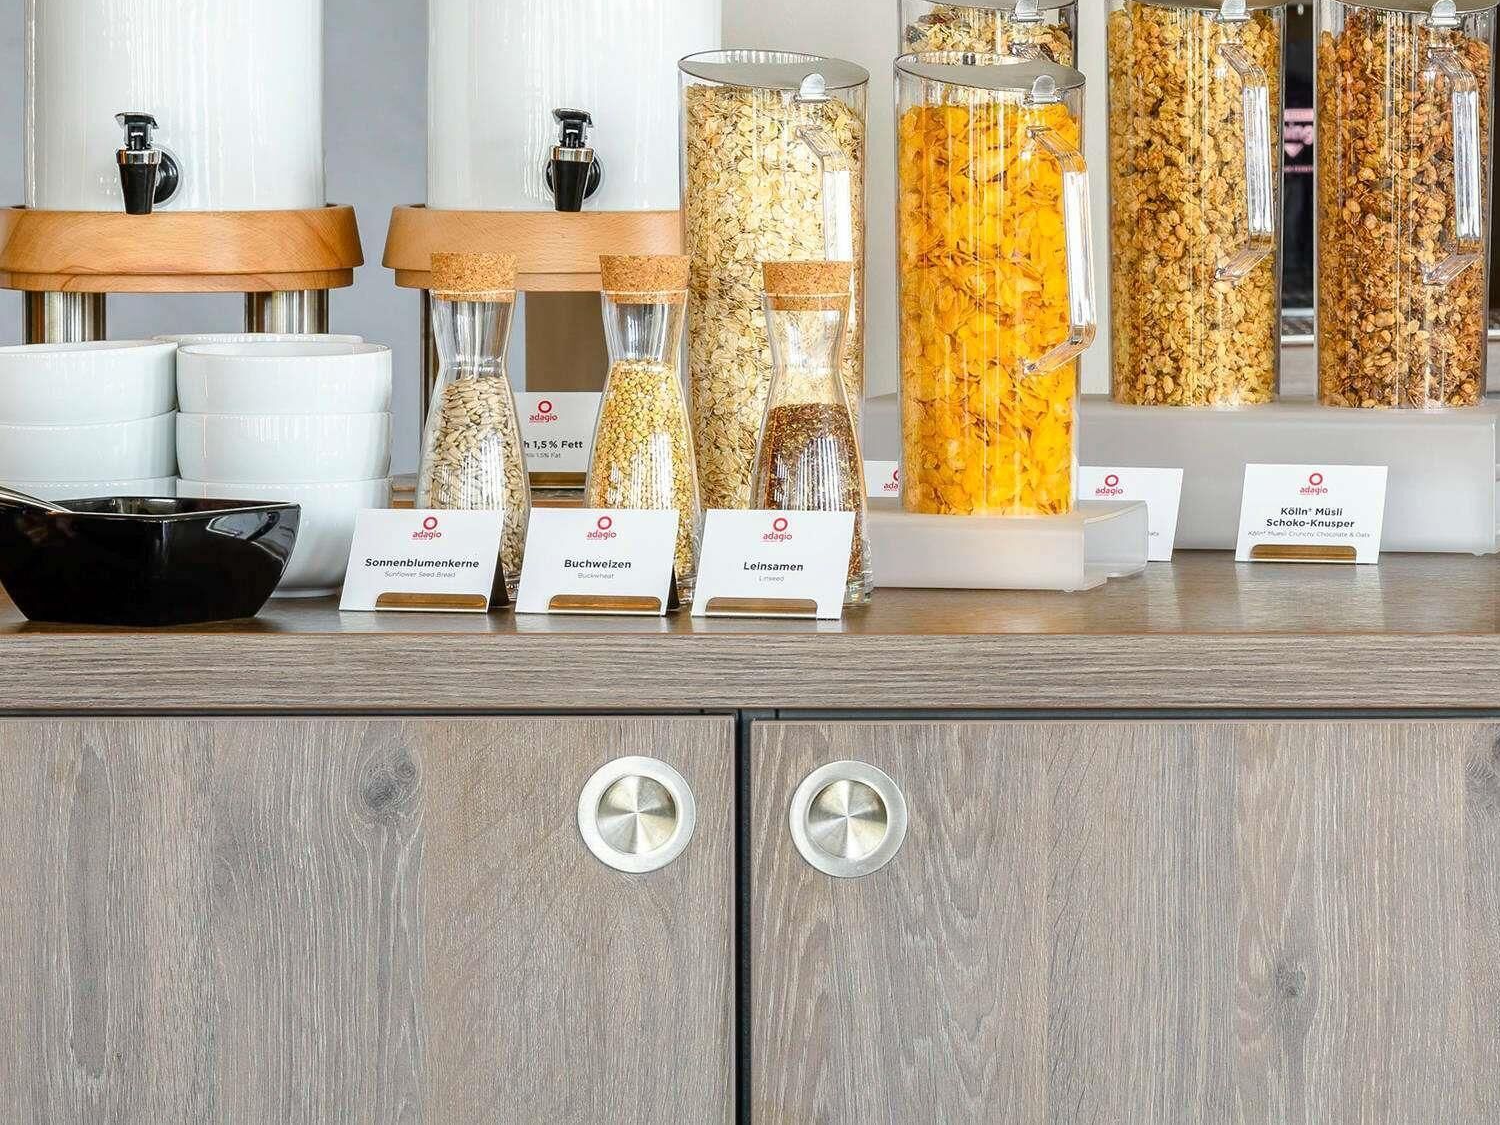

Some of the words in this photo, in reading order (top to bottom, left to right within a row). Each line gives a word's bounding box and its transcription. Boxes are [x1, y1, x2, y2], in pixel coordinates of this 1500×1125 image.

[529, 413, 558, 423] adagio
[561, 441, 583, 449] Fett
[1095, 486, 1124, 496] adagio
[1299, 485, 1328, 496] adagio
[1315, 507, 1343, 517] Müsli
[1266, 518, 1355, 529] Schoko-Knusper
[412, 530, 442, 540] adagio
[587, 530, 617, 540] adagio
[762, 532, 793, 542] adagio
[365, 558, 480, 568] Sonnenblumenkerne
[564, 559, 632, 569] Buchweizen
[743, 561, 804, 572] Leinsamen
